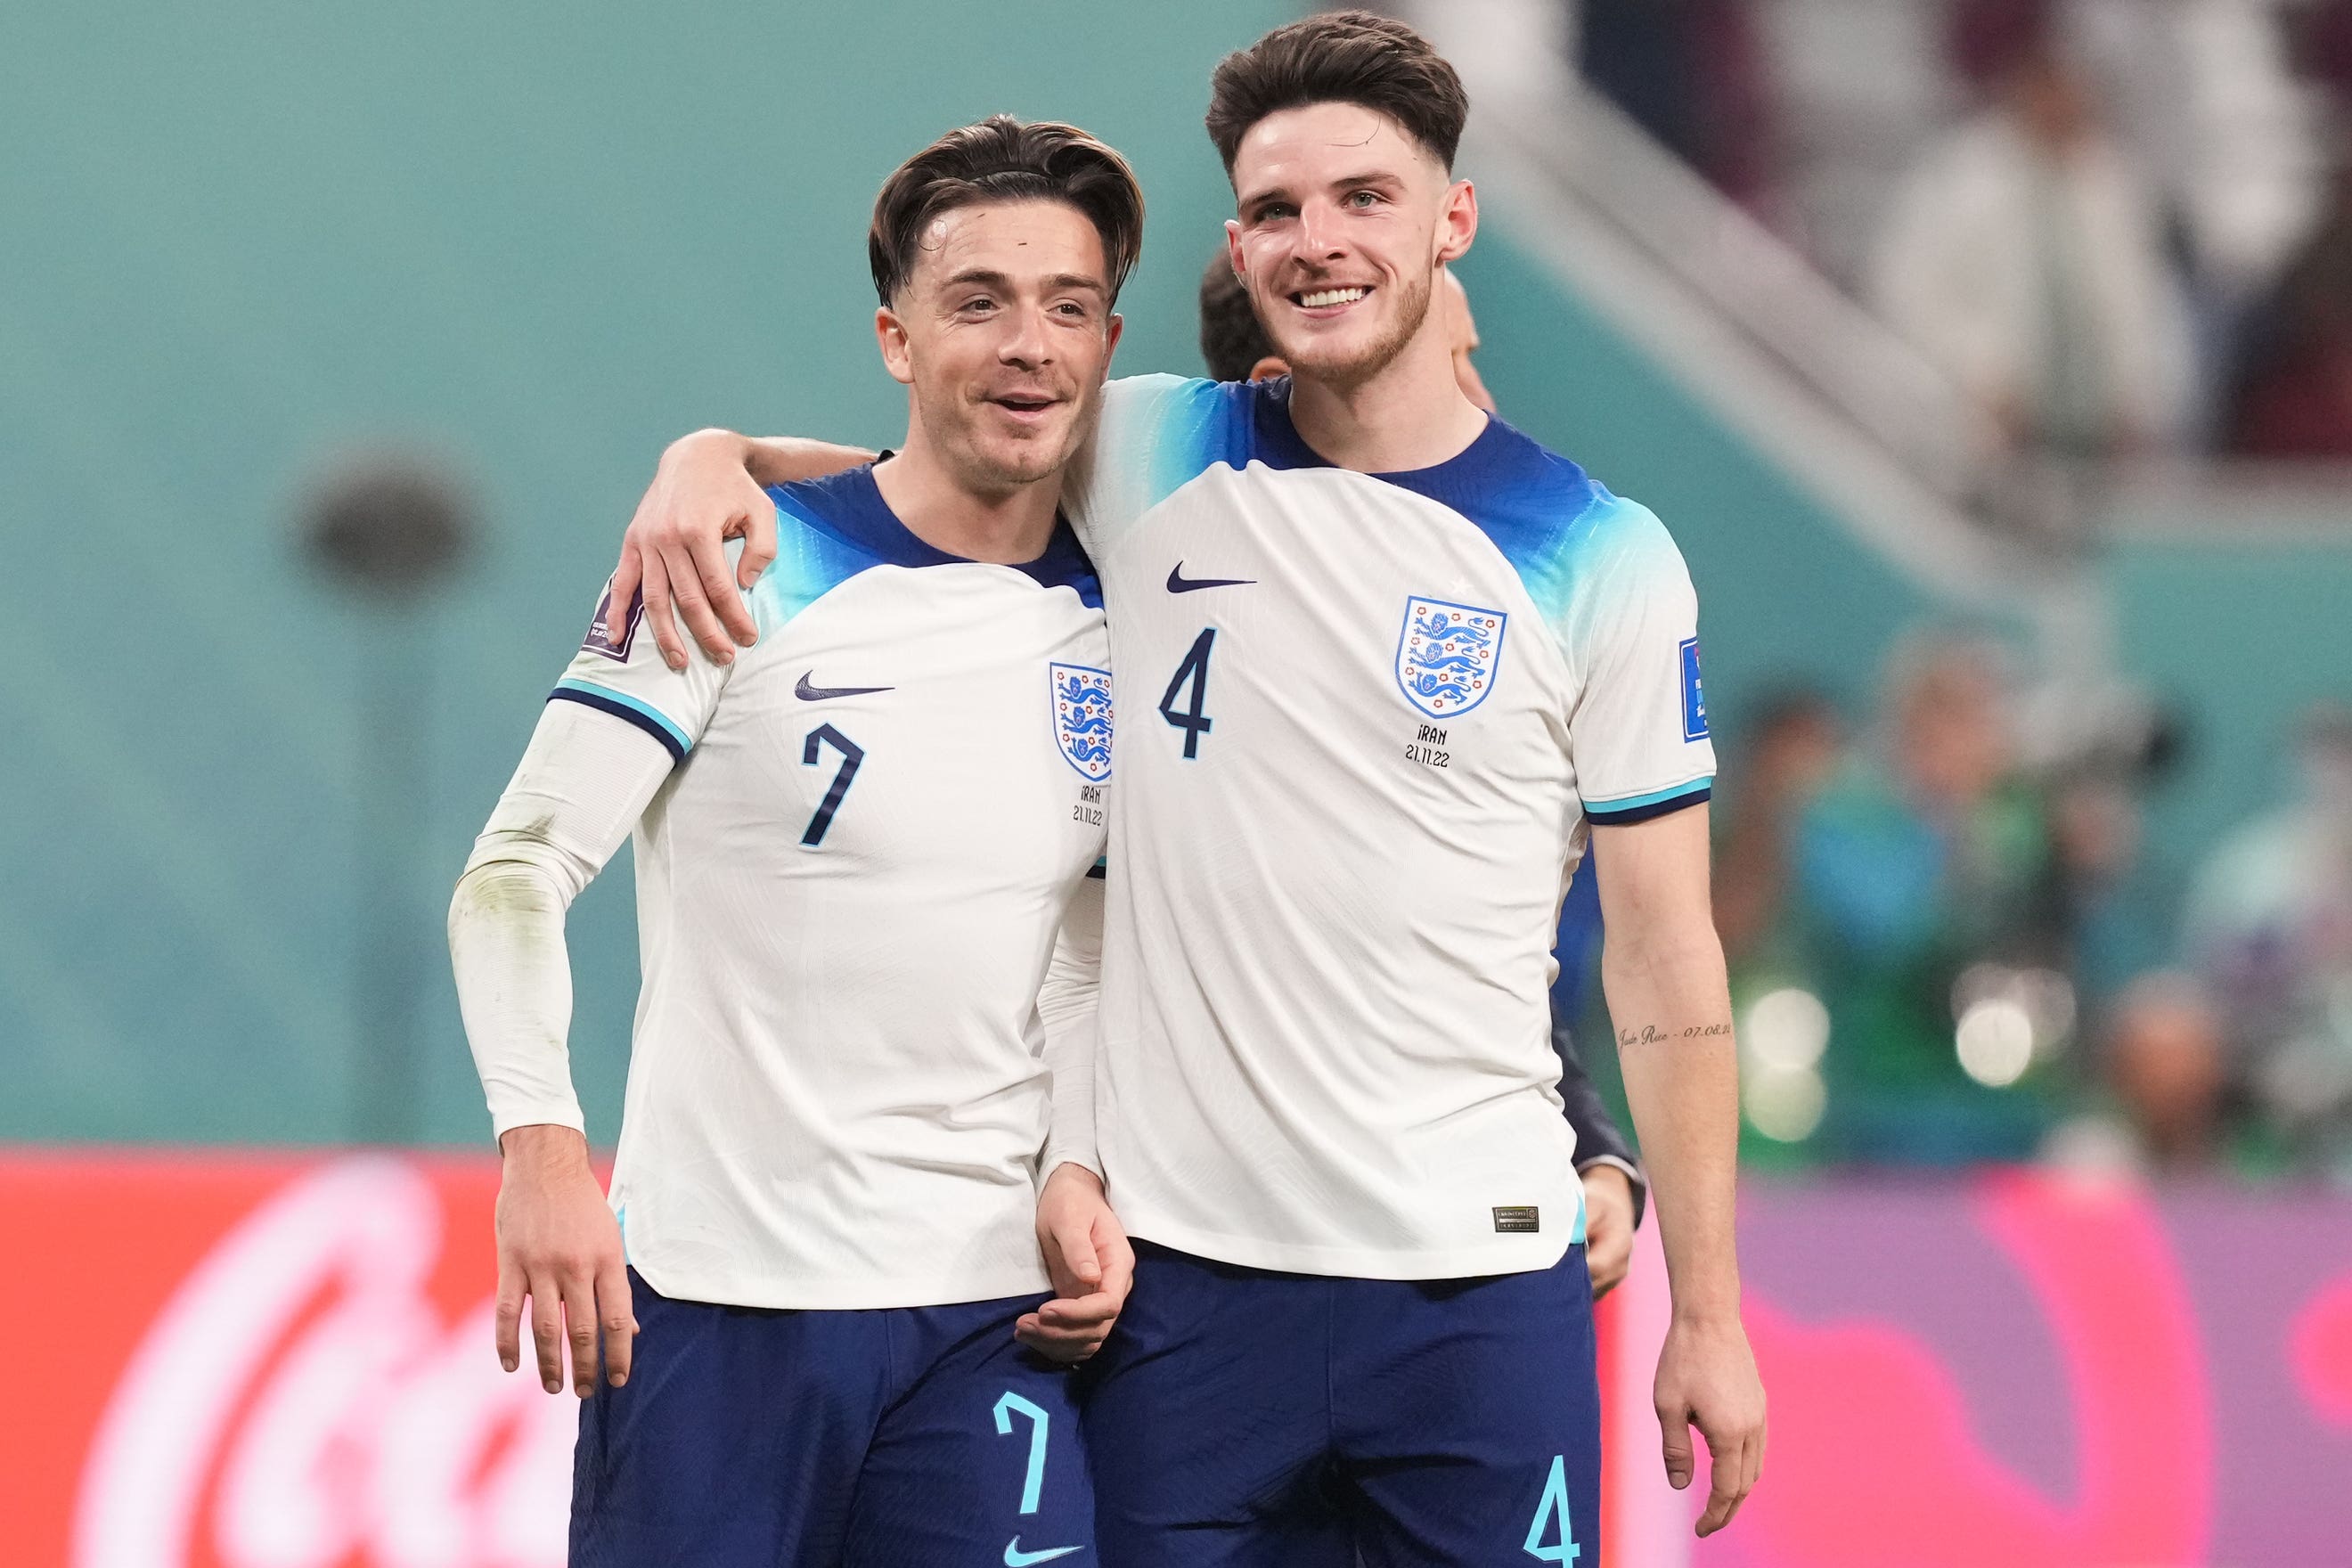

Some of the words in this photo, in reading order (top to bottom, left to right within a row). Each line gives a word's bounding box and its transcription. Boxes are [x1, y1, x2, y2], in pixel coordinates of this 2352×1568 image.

[1158, 628, 1217, 758] 4
[800, 722, 866, 846] 7
[1073, 804, 1103, 826] 21.11.22
[1405, 744, 1450, 767] 21.11.22
[993, 1391, 1049, 1515] 7
[1523, 1454, 1580, 1568] 4
